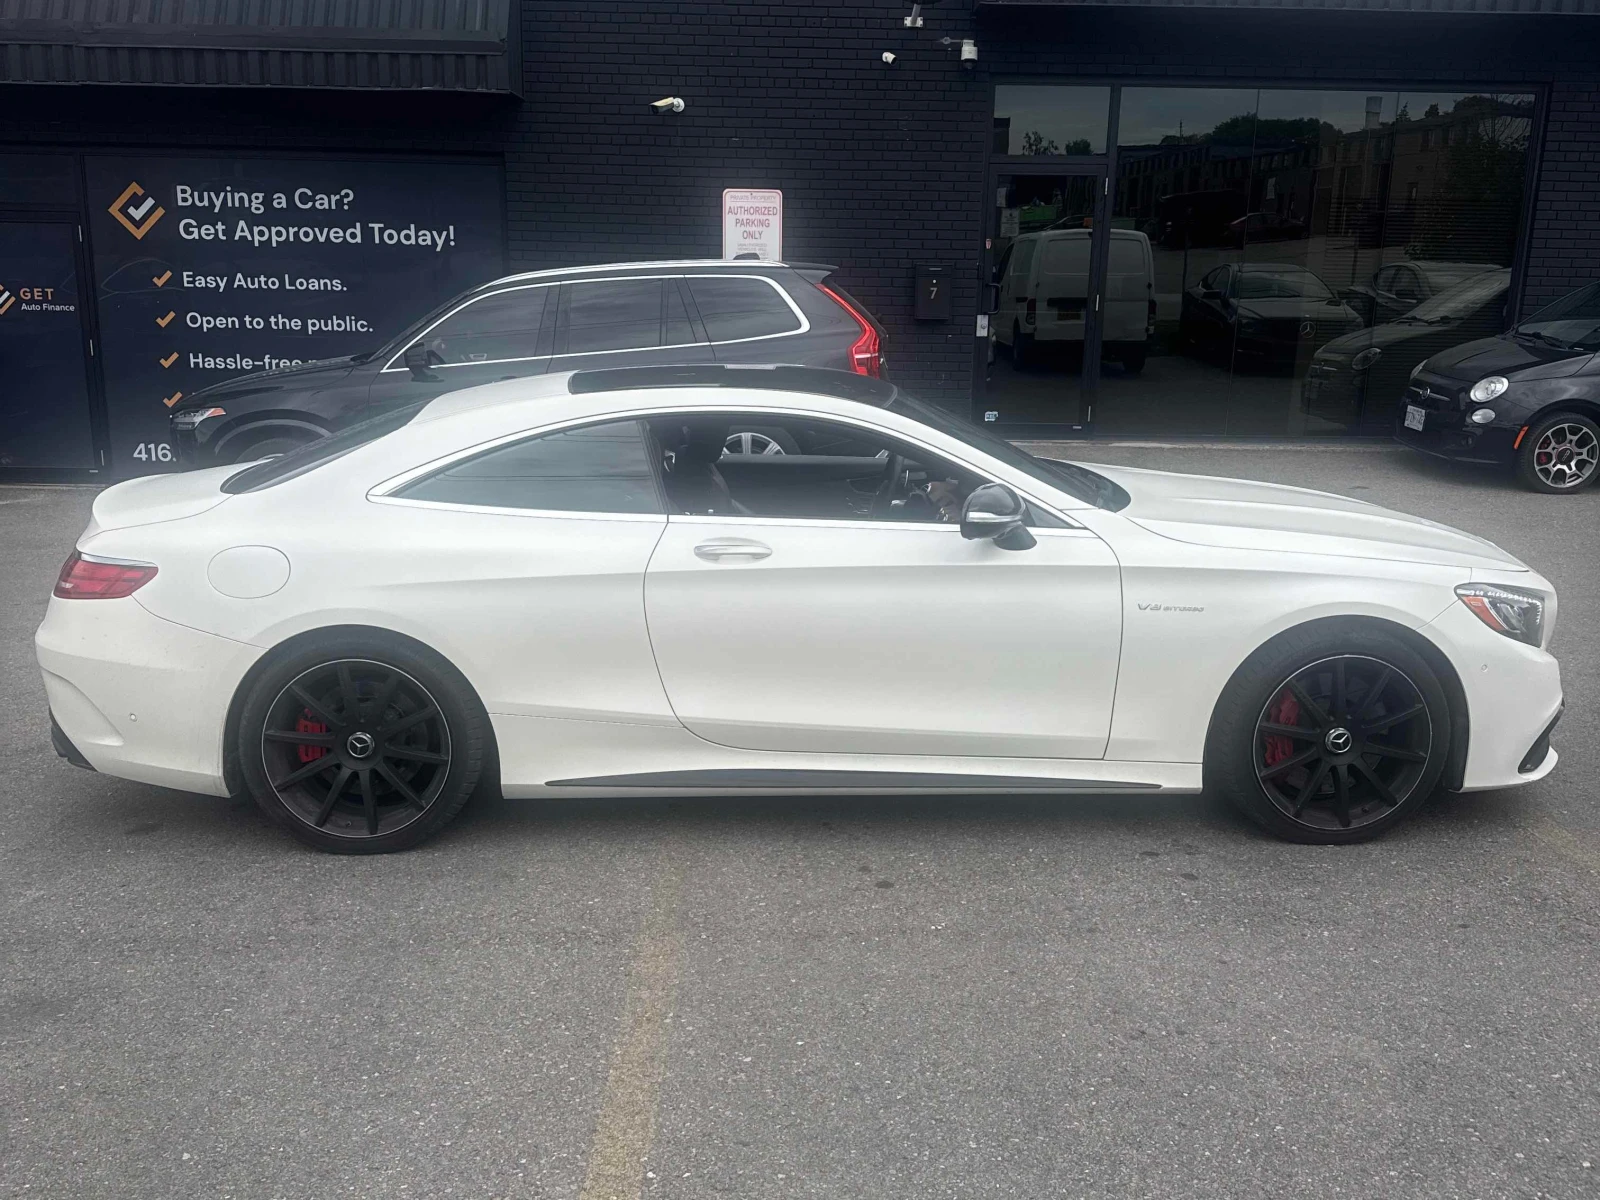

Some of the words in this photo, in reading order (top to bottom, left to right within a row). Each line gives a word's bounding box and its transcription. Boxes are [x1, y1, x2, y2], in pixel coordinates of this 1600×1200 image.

[176, 185, 265, 214] Buying
[272, 192, 287, 209] a
[294, 187, 354, 210] Car?
[727, 206, 778, 216] AUTHORIZED
[735, 218, 770, 228] PARKING
[179, 218, 227, 240] Get
[234, 219, 362, 247] Approved
[368, 223, 455, 252] Today!
[742, 230, 763, 240] ONLY
[182, 271, 228, 292] Easy
[233, 272, 280, 289] Auto
[284, 273, 348, 291] Loans.
[19, 287, 54, 300] GET
[929, 287, 938, 299] 7
[21, 302, 41, 311] Auto
[42, 303, 75, 312] Finance
[186, 311, 239, 332] Open
[243, 314, 264, 329] to
[269, 313, 302, 330] the
[307, 315, 374, 335] public.
[1137, 603, 1162, 611] V8
